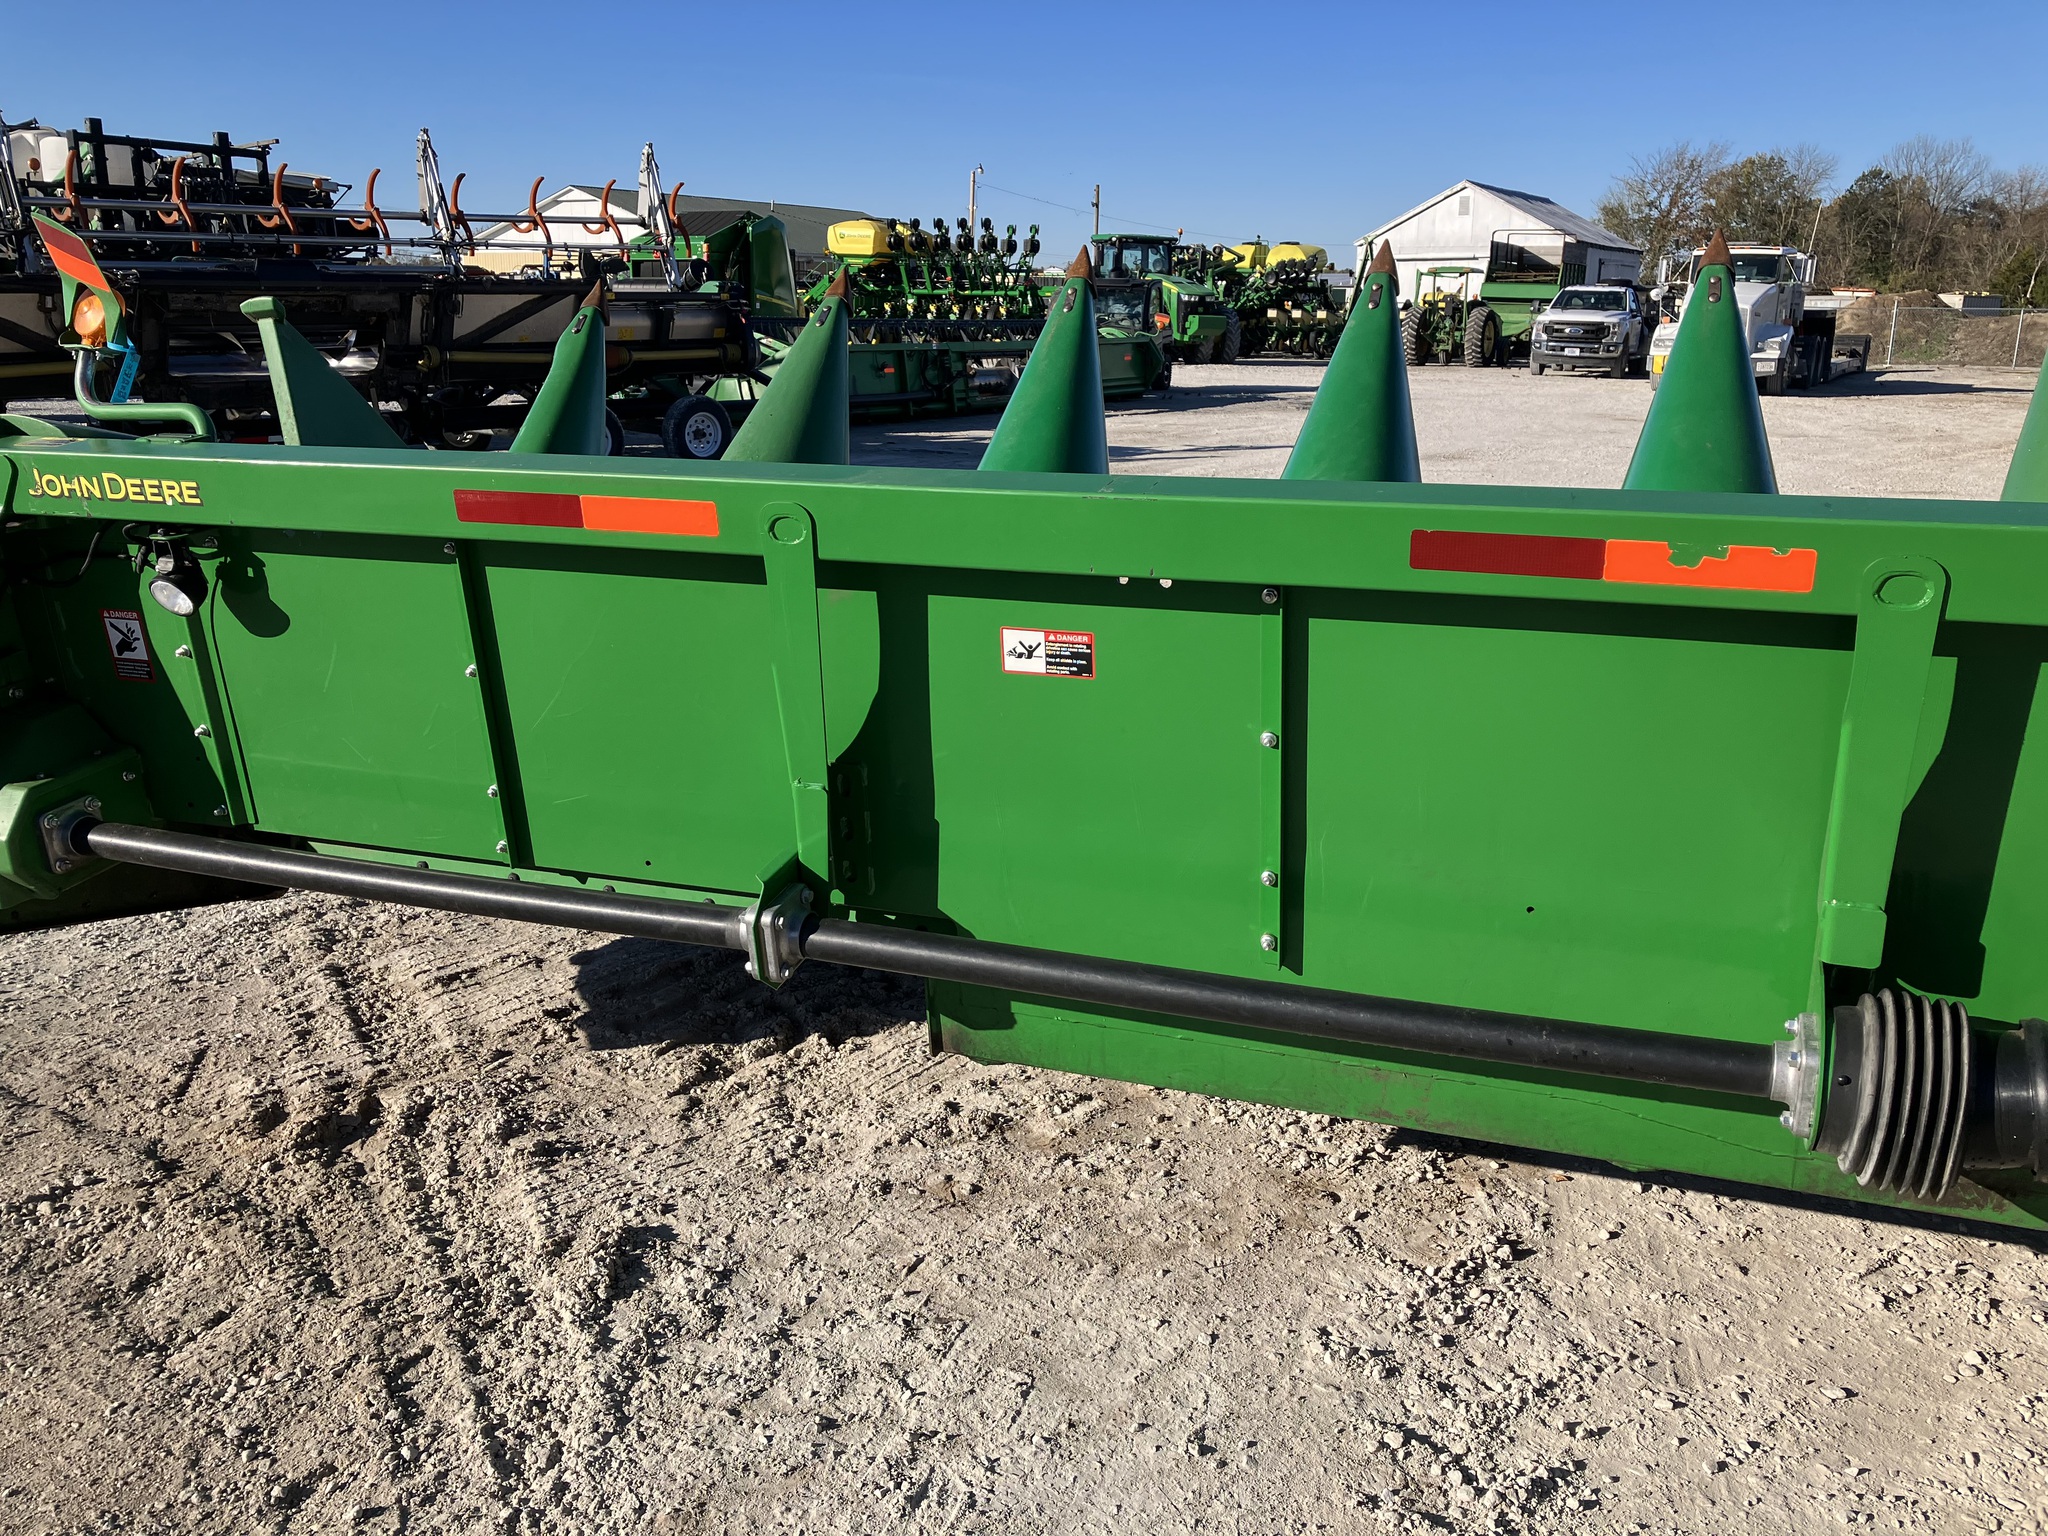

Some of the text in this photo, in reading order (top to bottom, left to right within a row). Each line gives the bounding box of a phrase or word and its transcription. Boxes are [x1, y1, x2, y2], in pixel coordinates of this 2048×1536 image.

[28, 467, 203, 505] JOHN DEERE
[109, 610, 138, 619] DANGER
[1056, 634, 1089, 643] DANGER
